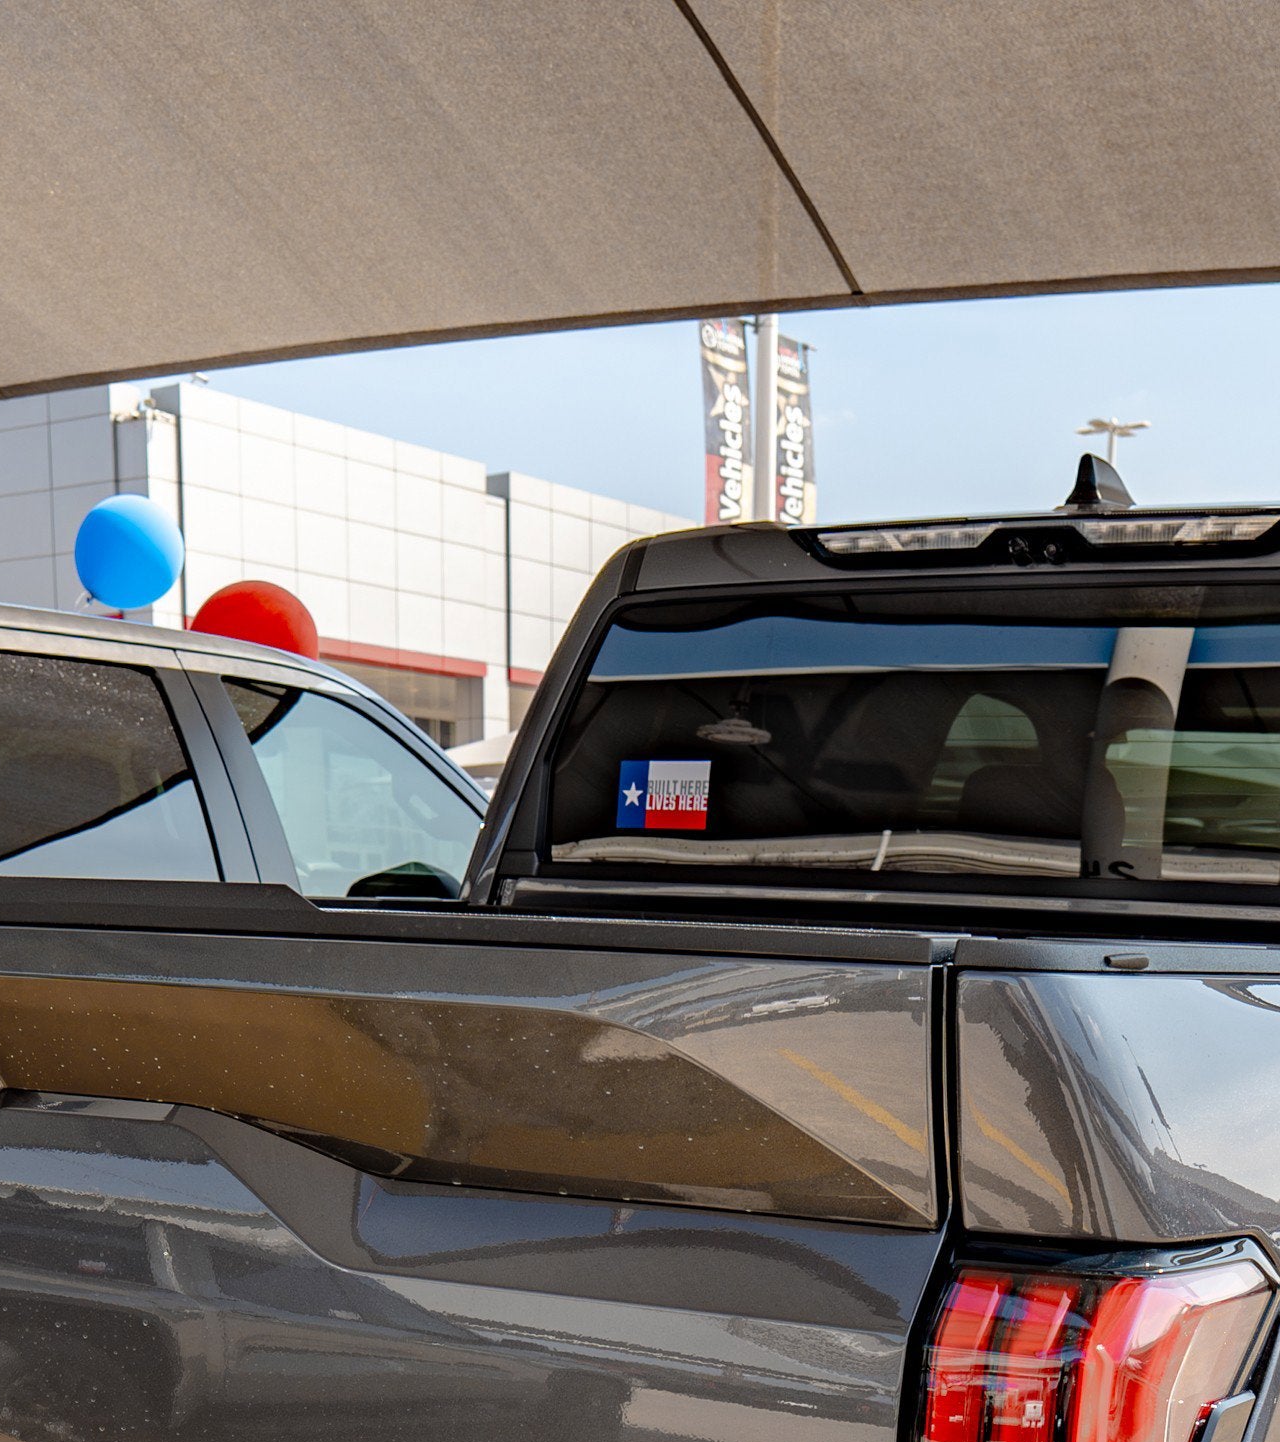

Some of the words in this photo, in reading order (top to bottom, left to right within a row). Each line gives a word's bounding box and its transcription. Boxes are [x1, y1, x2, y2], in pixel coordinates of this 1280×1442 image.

[718, 383, 743, 521] Vehicles
[647, 779, 678, 795] BUILT
[681, 780, 709, 796] HERE
[645, 794, 676, 811] LIVES
[678, 795, 708, 811] HERE
